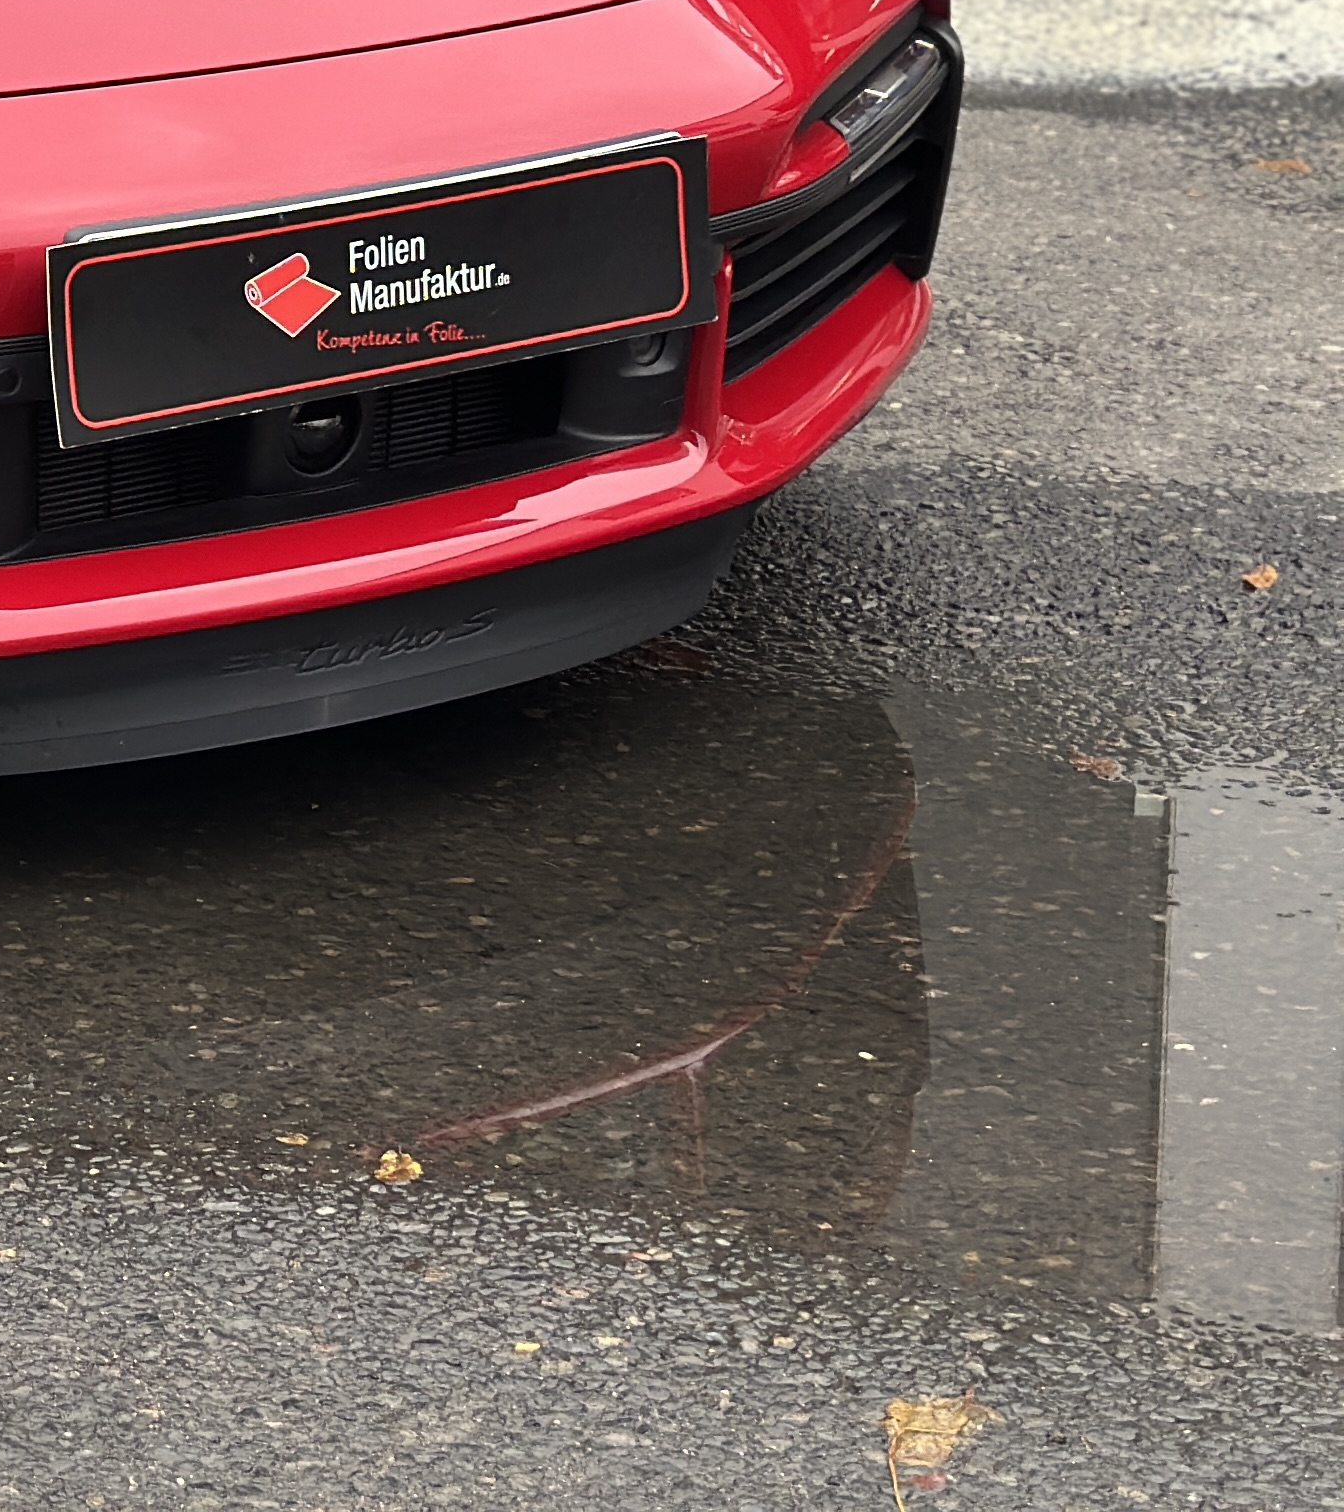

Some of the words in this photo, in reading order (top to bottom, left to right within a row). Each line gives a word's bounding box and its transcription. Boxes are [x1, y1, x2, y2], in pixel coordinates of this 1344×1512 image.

[348, 234, 426, 274] Folien
[316, 328, 402, 354] Kompetenz
[405, 326, 420, 344] in
